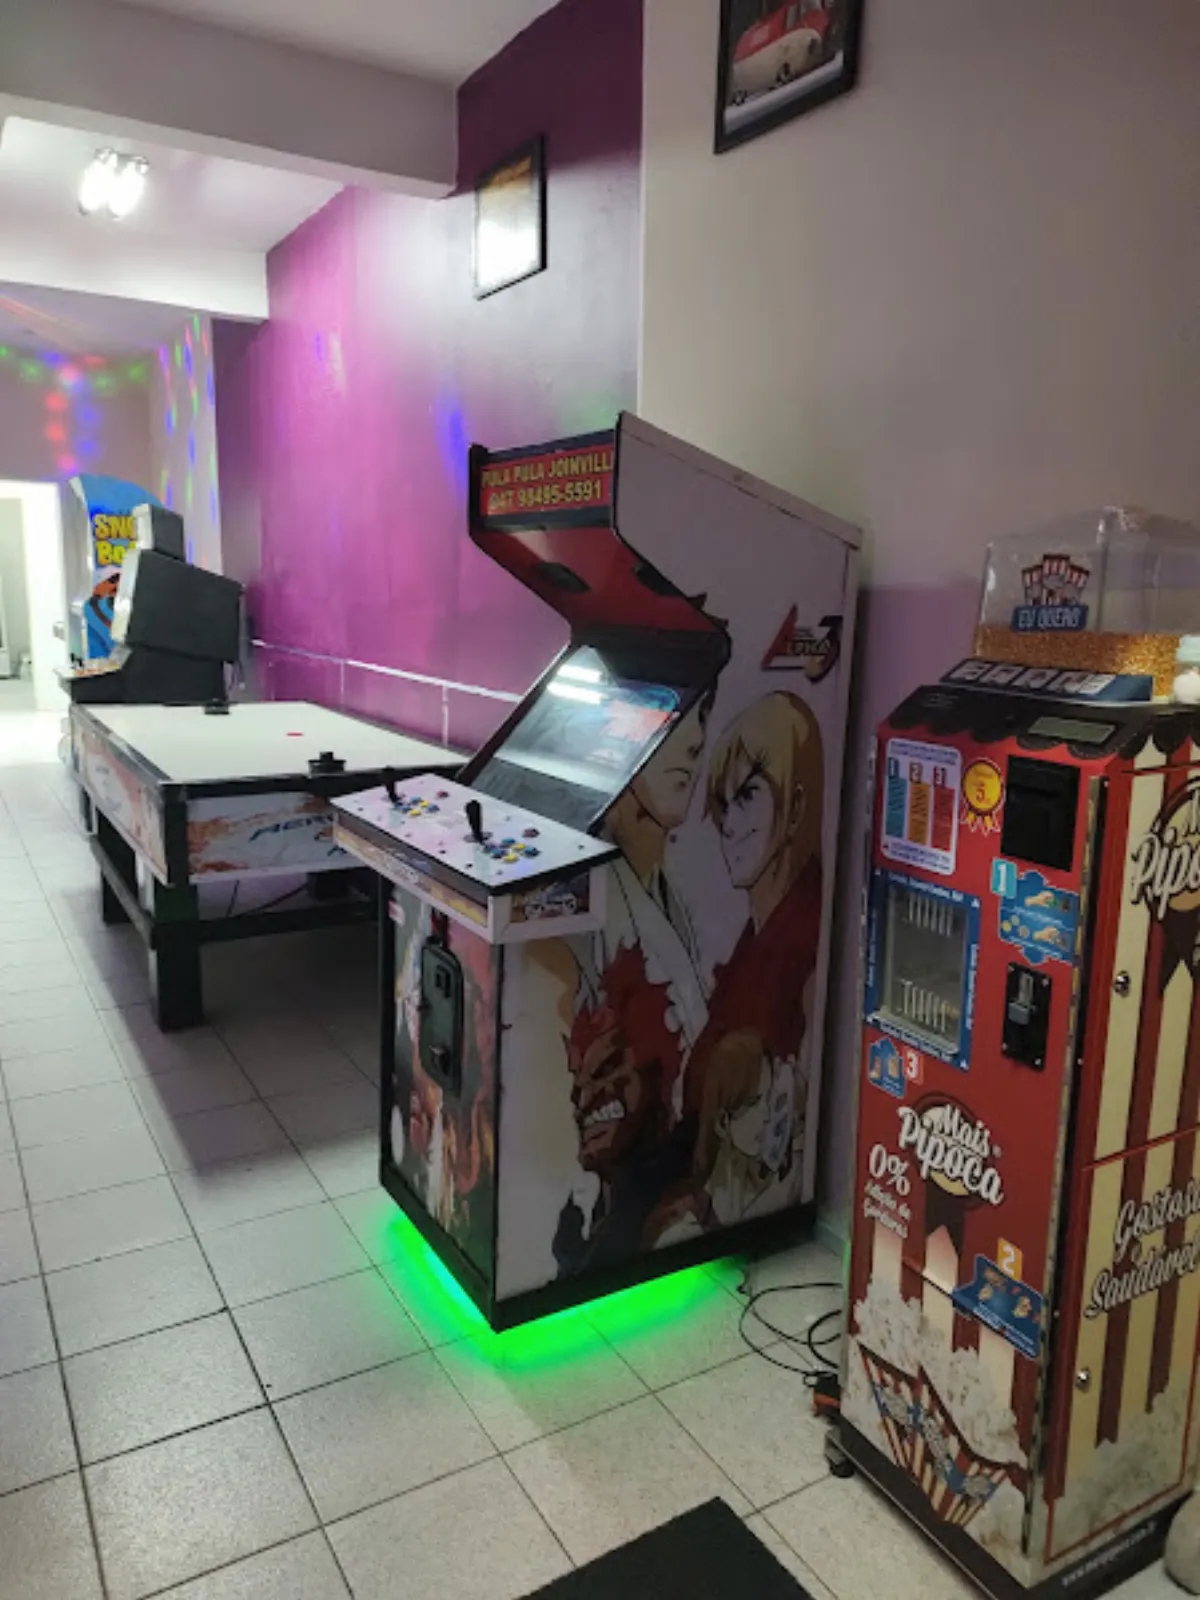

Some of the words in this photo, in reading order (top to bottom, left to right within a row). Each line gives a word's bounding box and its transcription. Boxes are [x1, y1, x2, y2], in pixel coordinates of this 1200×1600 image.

[514, 462, 544, 482] PULA
[549, 451, 614, 478] JOINVILL
[1019, 609, 1036, 628] EU
[998, 864, 1007, 892] 1
[905, 1049, 919, 1078] 3
[932, 1104, 991, 1159] Mais
[869, 1143, 911, 1197] 0%
[896, 1106, 1005, 1206] Pipoca
[1002, 1244, 1016, 1277] 2
